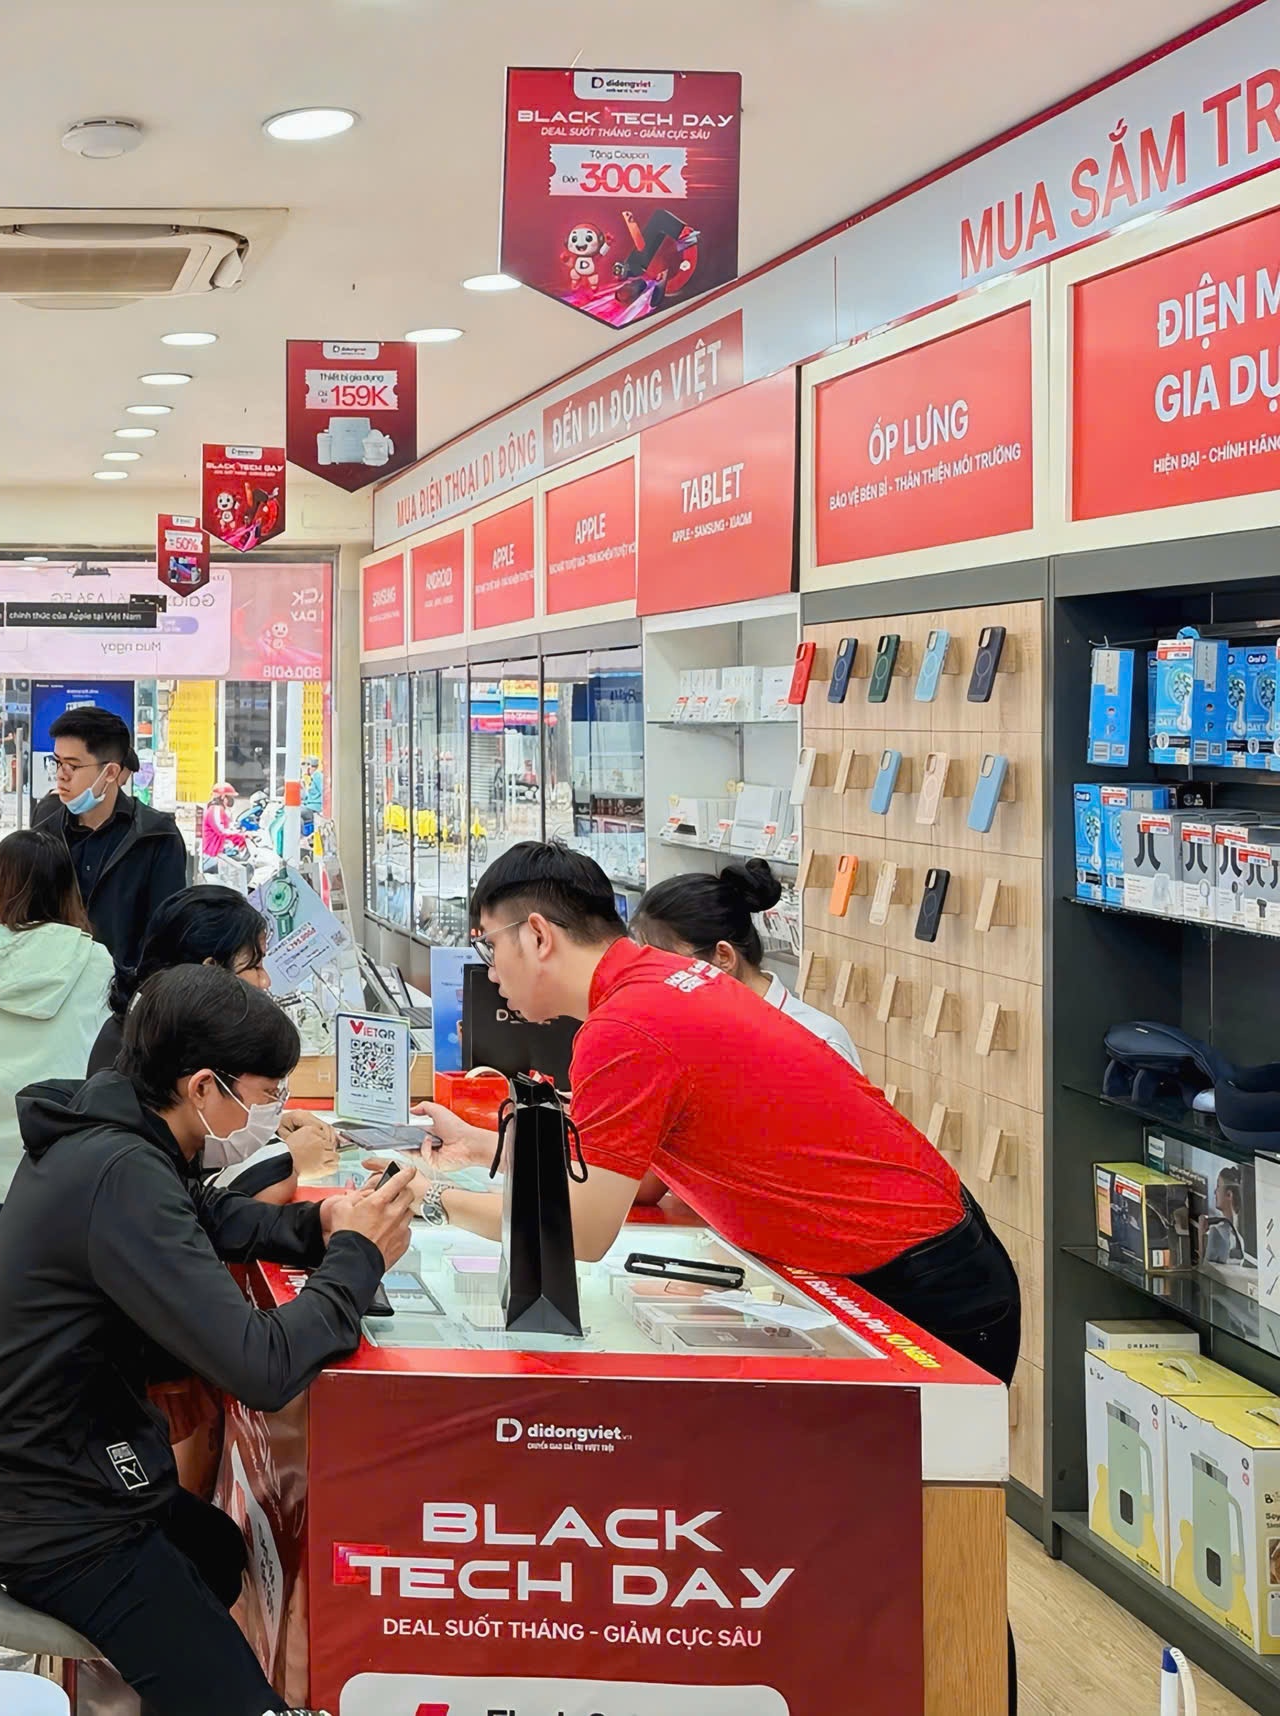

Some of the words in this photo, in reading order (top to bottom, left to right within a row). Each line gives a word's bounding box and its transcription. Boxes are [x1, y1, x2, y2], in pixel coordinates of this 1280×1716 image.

[606, 80, 651, 88] didongviet
[517, 110, 600, 124] BLACK
[611, 113, 672, 126] TECH
[683, 114, 734, 127] DAY
[541, 126, 567, 136] DEAL
[615, 151, 649, 160] Coupon
[580, 163, 672, 194] 300K
[961, 181, 1057, 280] MUA
[1070, 117, 1186, 228] SẮM
[1157, 272, 1245, 350] ĐIỆN
[331, 385, 389, 406] 159K
[552, 399, 583, 454] ĐẾN
[588, 402, 604, 438] DI
[610, 369, 662, 432] ĐỘNG
[670, 338, 722, 402] VIỆT
[1155, 364, 1220, 422] GIA
[869, 416, 898, 465] ỐP
[904, 400, 968, 456] LƯNG
[894, 470, 920, 492] THÂN
[922, 462, 952, 484] THIỆN
[953, 454, 972, 477] MÔI
[975, 442, 1021, 472] TRƯỜNG
[1154, 454, 1178, 474] HIỆN
[1180, 451, 1200, 470] ĐẠI
[1209, 442, 1247, 462] CHÍNH
[397, 496, 418, 528] MUA
[482, 454, 495, 484] DI
[497, 429, 537, 482] ĐỘNG
[681, 462, 744, 513] TABLET
[176, 536, 198, 550] 50%
[575, 513, 606, 544] APPLE
[672, 527, 692, 542] APPLE
[492, 544, 514, 570] APPLE
[9, 611, 32, 620] chính
[32, 612, 50, 620] thức
[52, 611, 66, 620] của
[68, 612, 92, 621] Apple
[93, 612, 104, 621] tại
[105, 612, 122, 622] Việt
[123, 612, 142, 620] Nam
[350, 1020, 396, 1040] VIETQR
[422, 1502, 722, 1552] BLACK
[348, 1556, 572, 1602] TECH
[612, 1565, 796, 1609] DAY
[384, 1618, 440, 1636] DEAL
[445, 1614, 502, 1638] SUỐT
[508, 1618, 584, 1641] THÁNG
[604, 1620, 662, 1645] GIẢM
[667, 1628, 712, 1650] CỰC
[718, 1626, 762, 1647] SÂU
